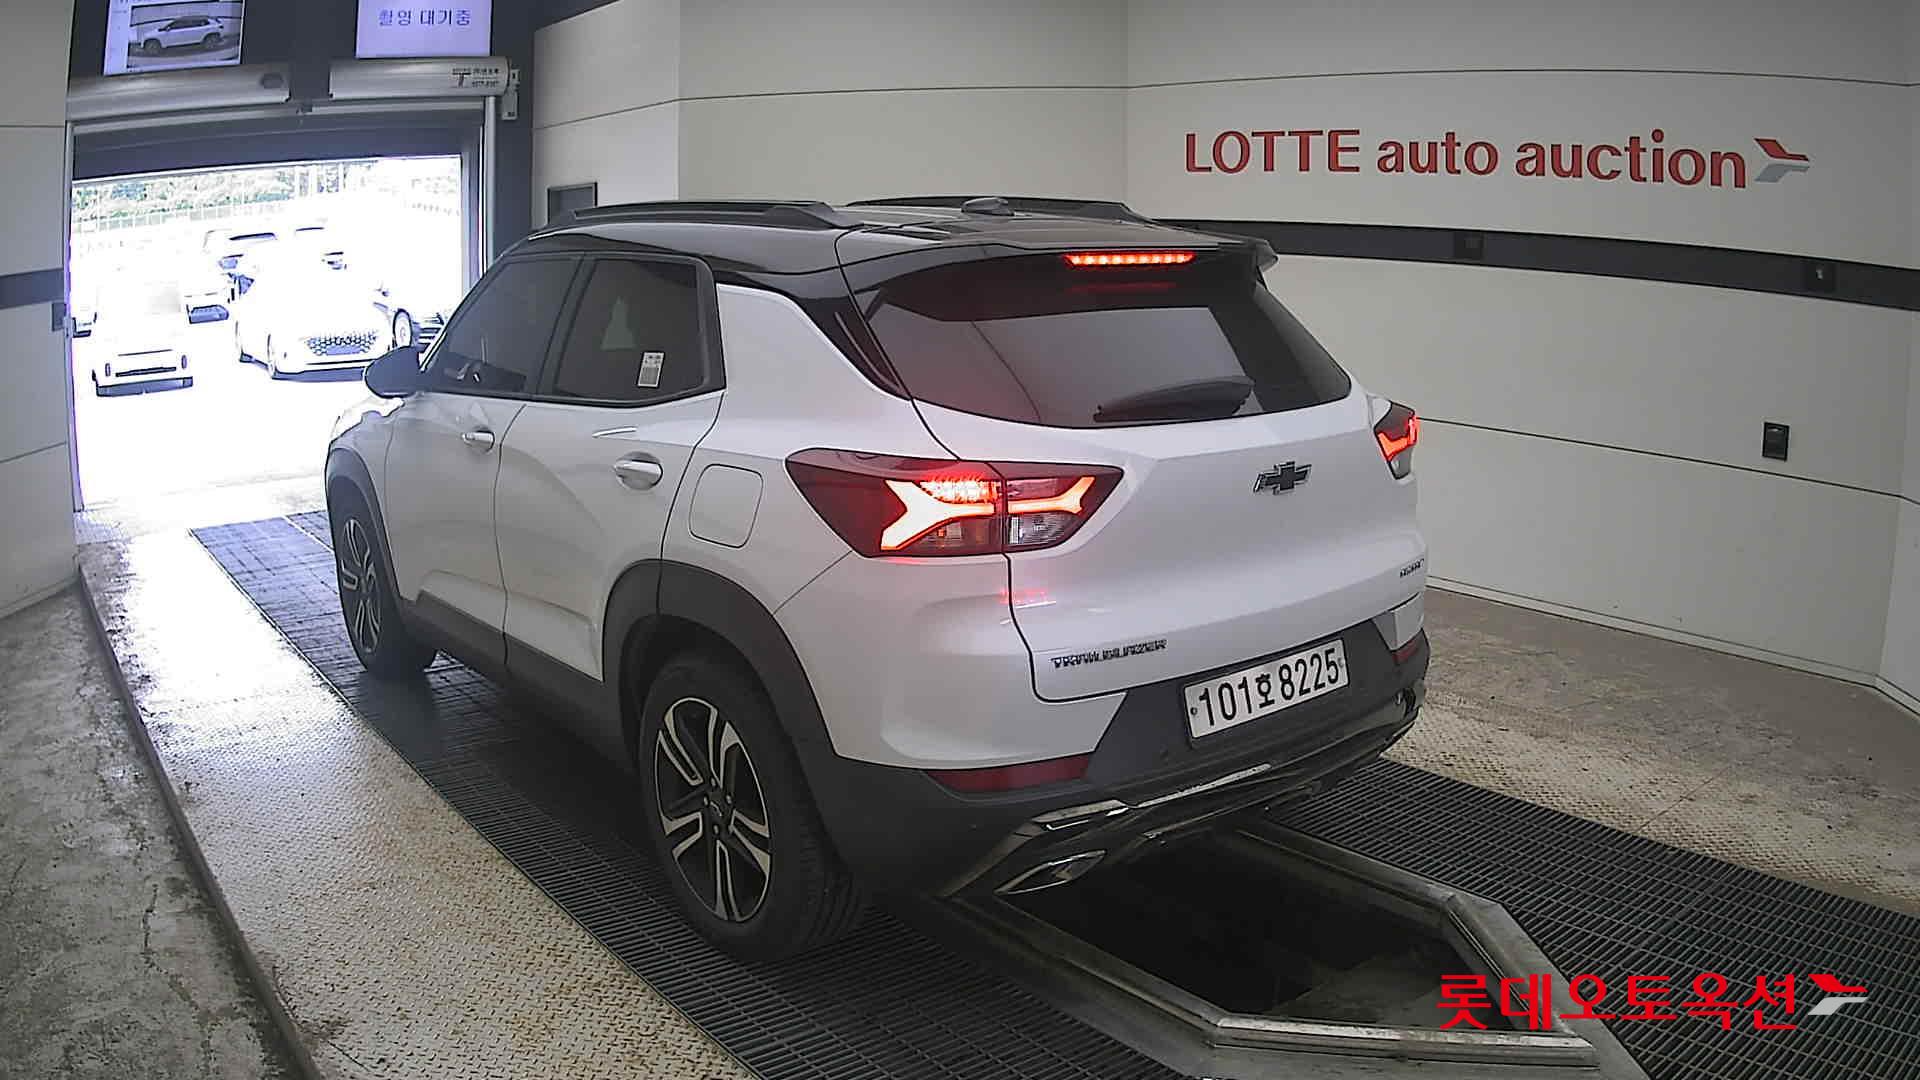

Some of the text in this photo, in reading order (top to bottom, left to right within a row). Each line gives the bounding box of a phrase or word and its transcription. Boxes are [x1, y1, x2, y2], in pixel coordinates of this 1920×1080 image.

[420, 10, 471, 26] 대기중
[1185, 129, 1747, 189] LOTTE auto auction
